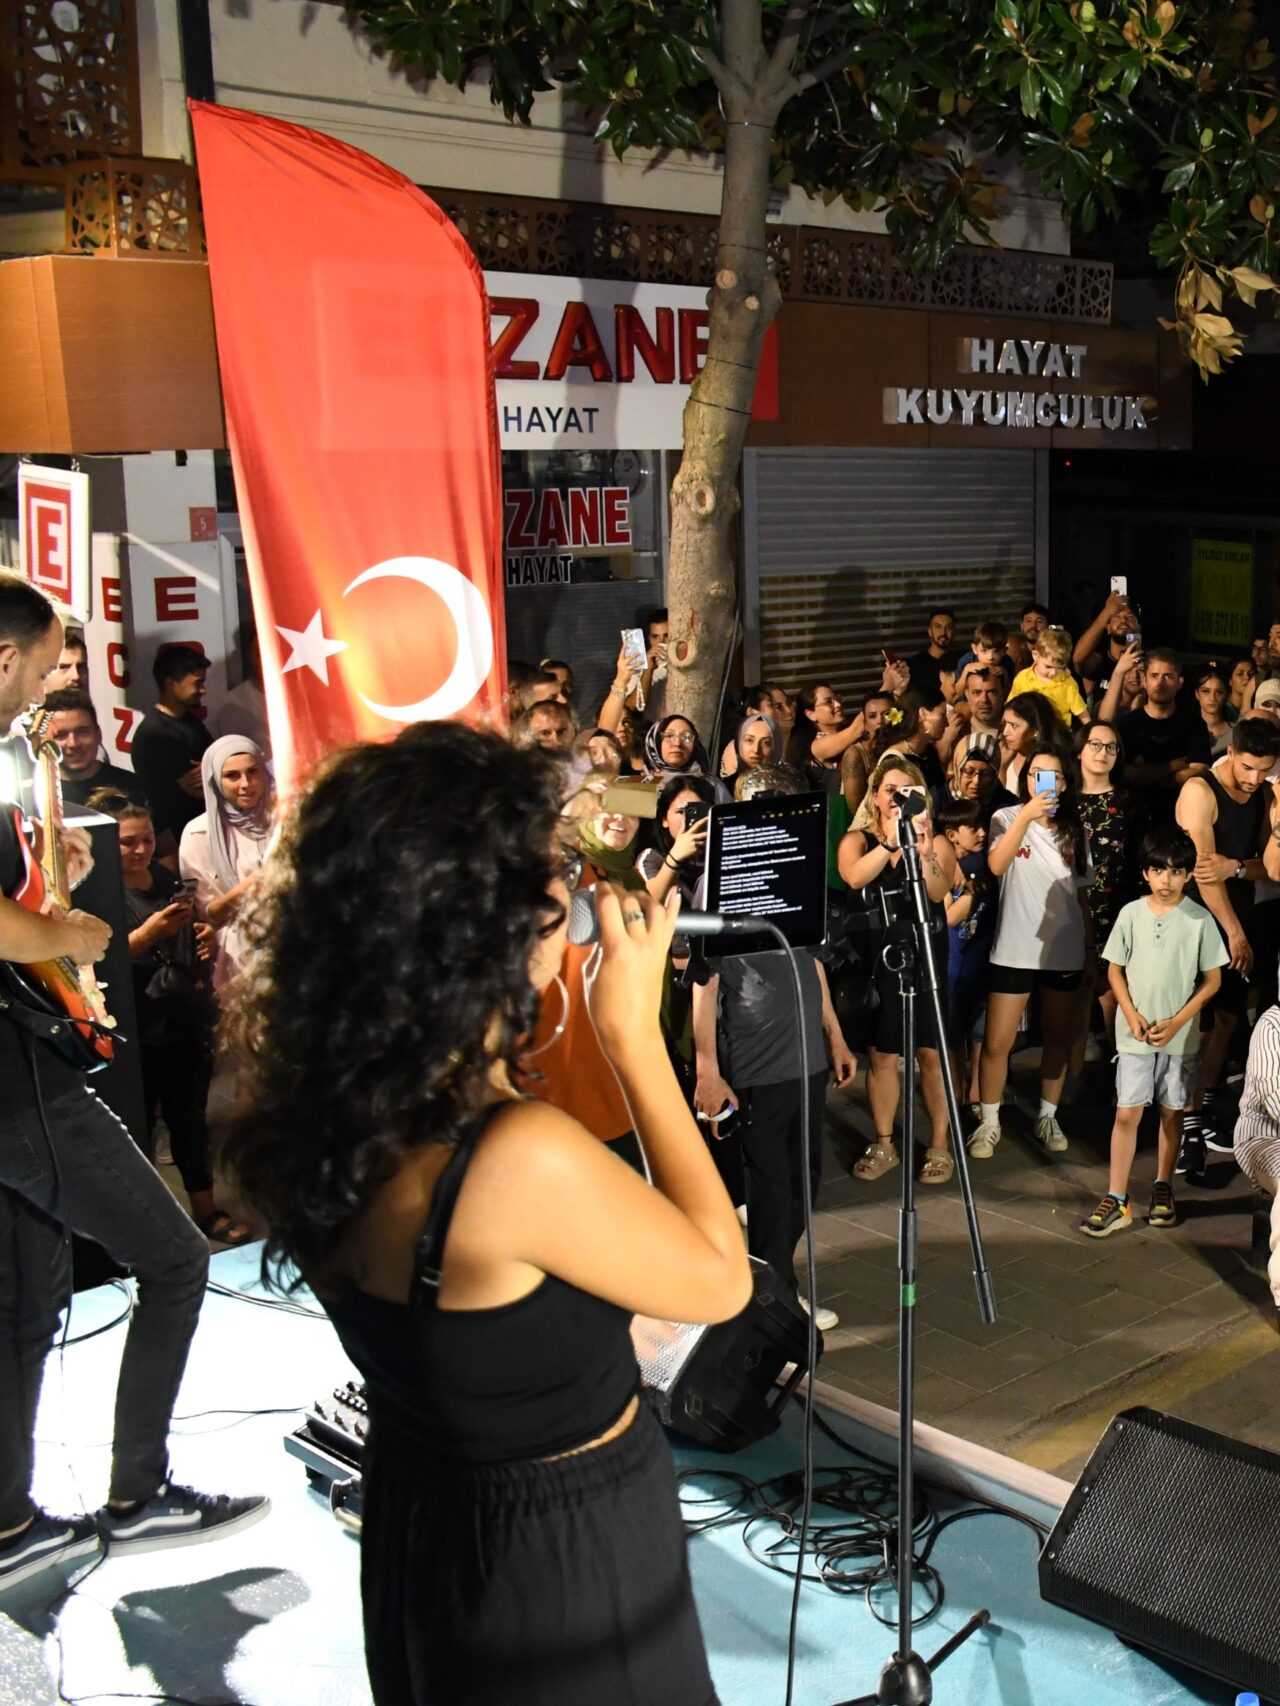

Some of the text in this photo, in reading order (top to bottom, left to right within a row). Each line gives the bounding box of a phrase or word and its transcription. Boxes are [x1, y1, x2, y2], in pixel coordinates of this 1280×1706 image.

[971, 338, 1087, 377] HAYAT
[503, 406, 599, 433] HAYAT
[896, 386, 1147, 430] KUYUMCULUK
[505, 487, 632, 549] ZANE
[37, 505, 63, 583] E
[507, 553, 573, 587] HAYAT
